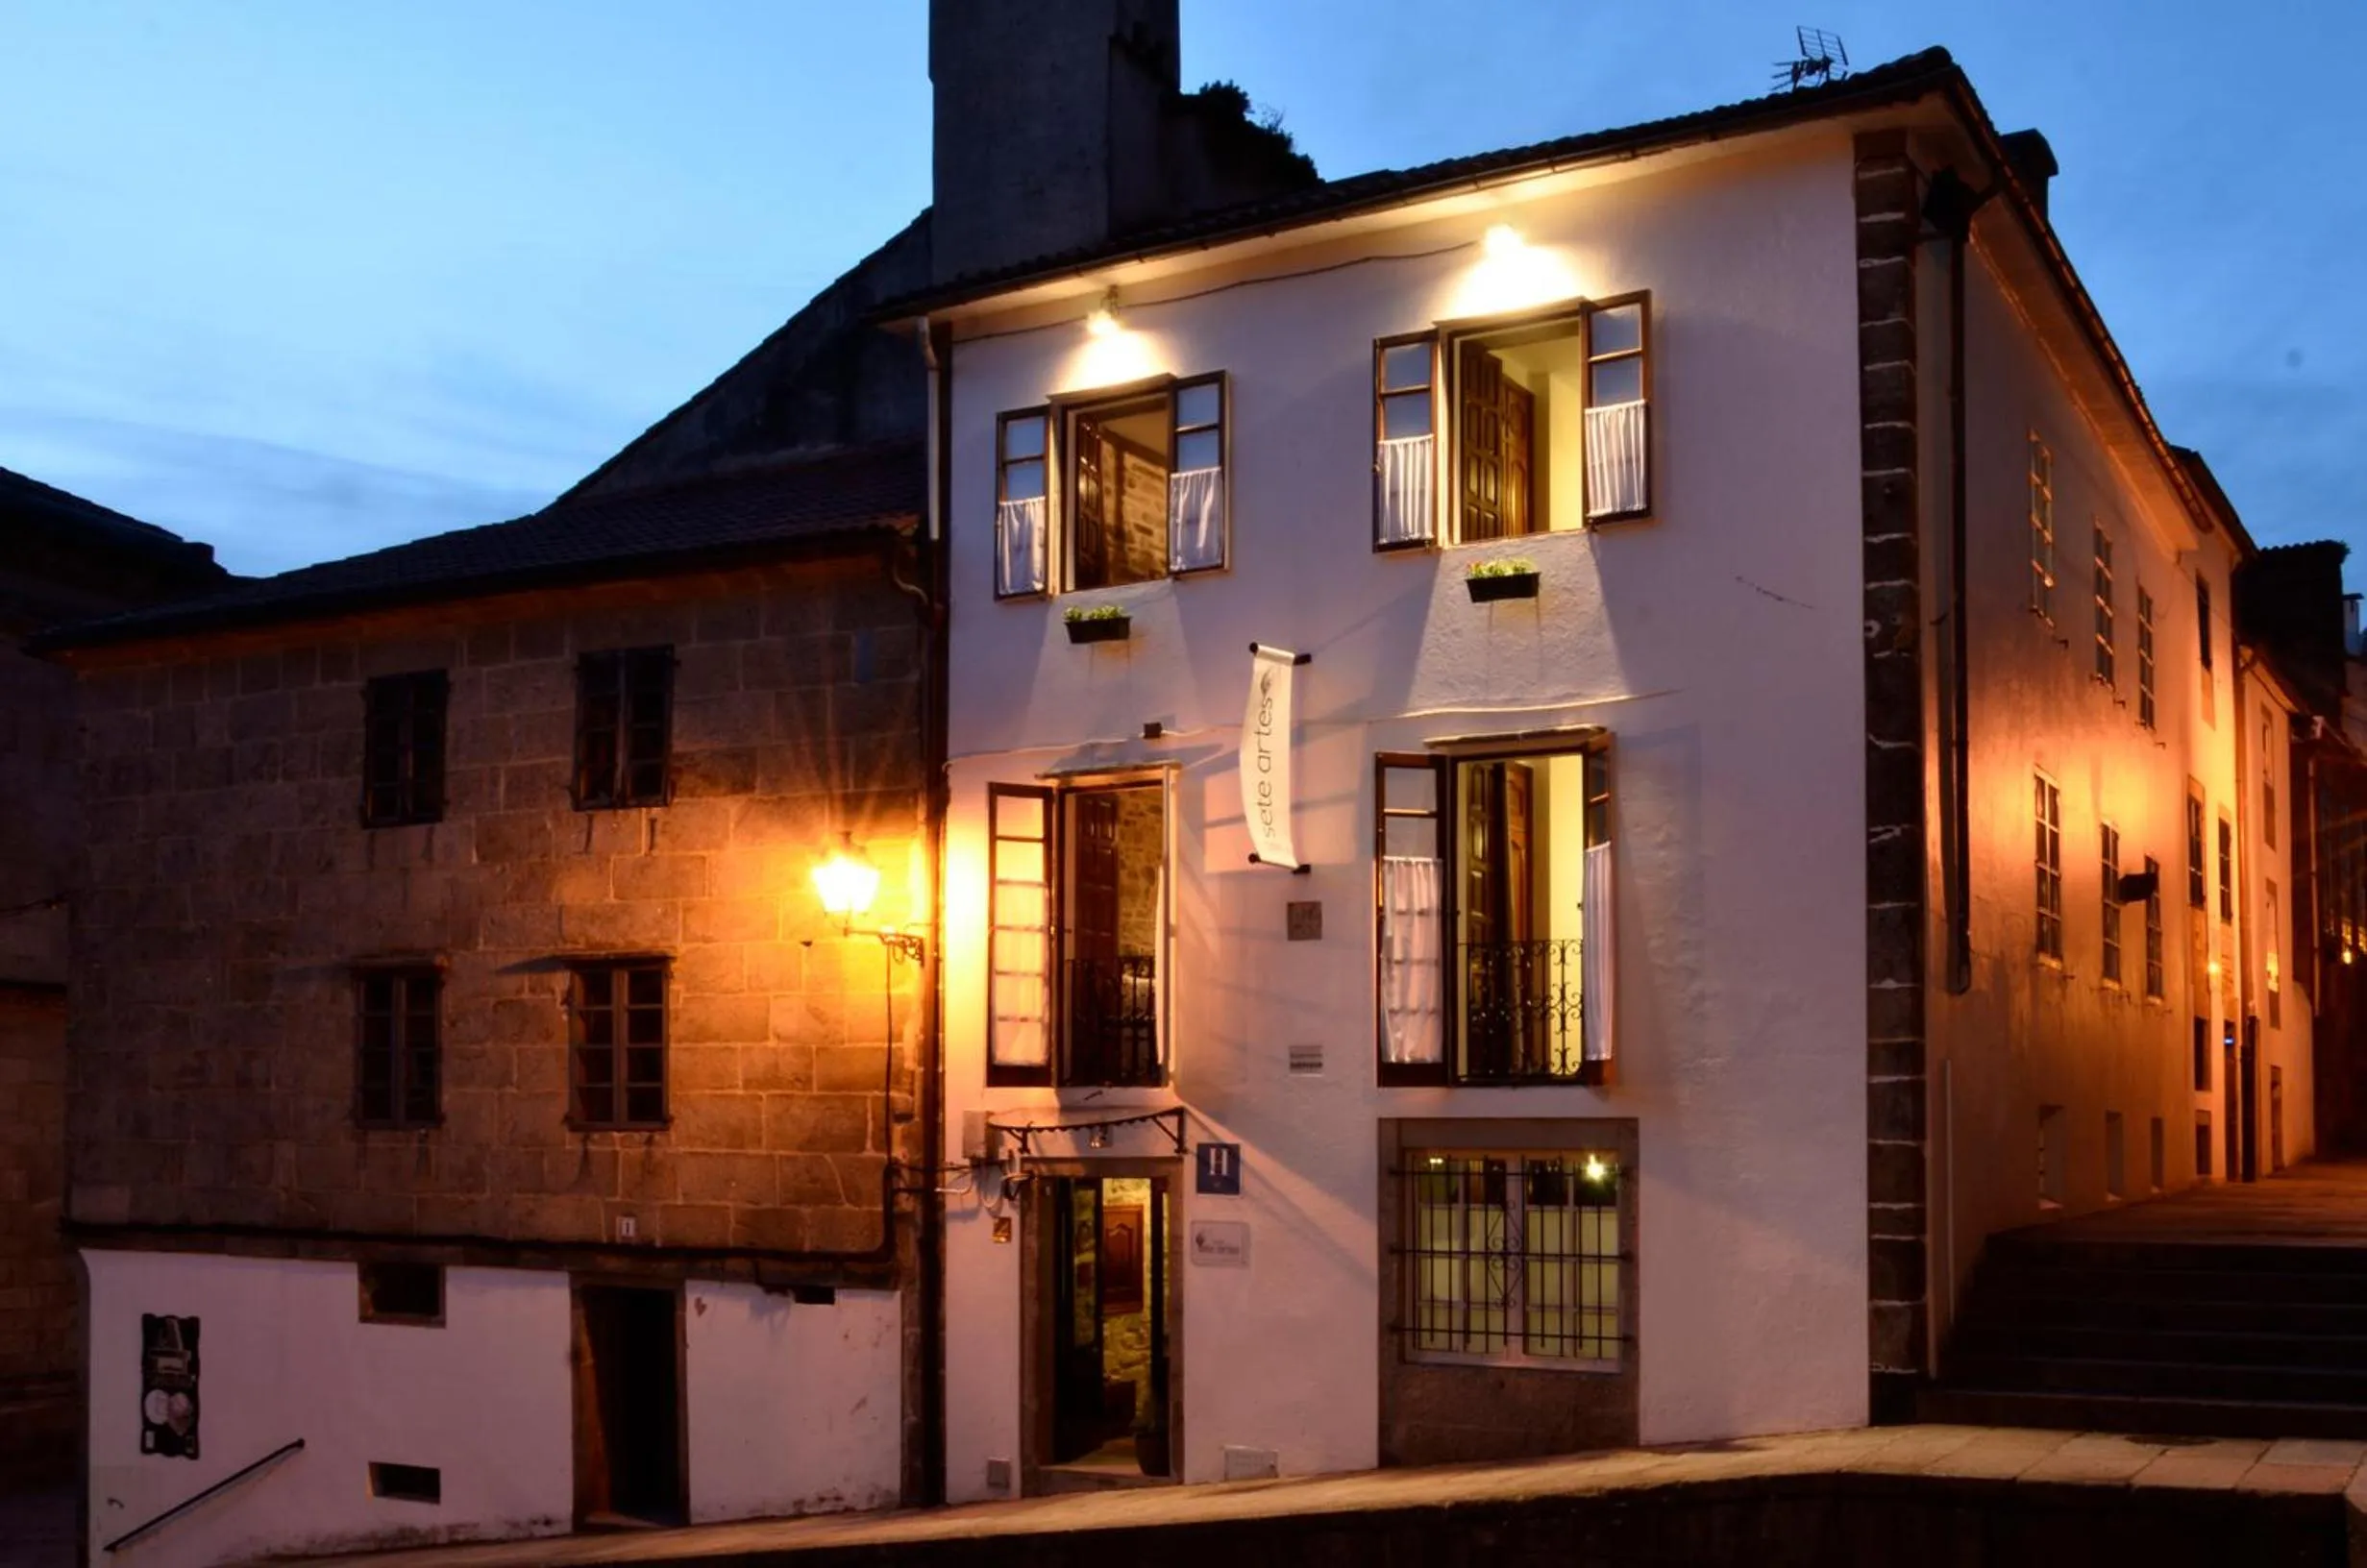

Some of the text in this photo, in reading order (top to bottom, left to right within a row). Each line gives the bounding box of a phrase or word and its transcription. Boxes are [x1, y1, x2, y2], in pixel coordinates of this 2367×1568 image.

[1254, 698, 1275, 839] sete artes
[1209, 1147, 1228, 1176] H
